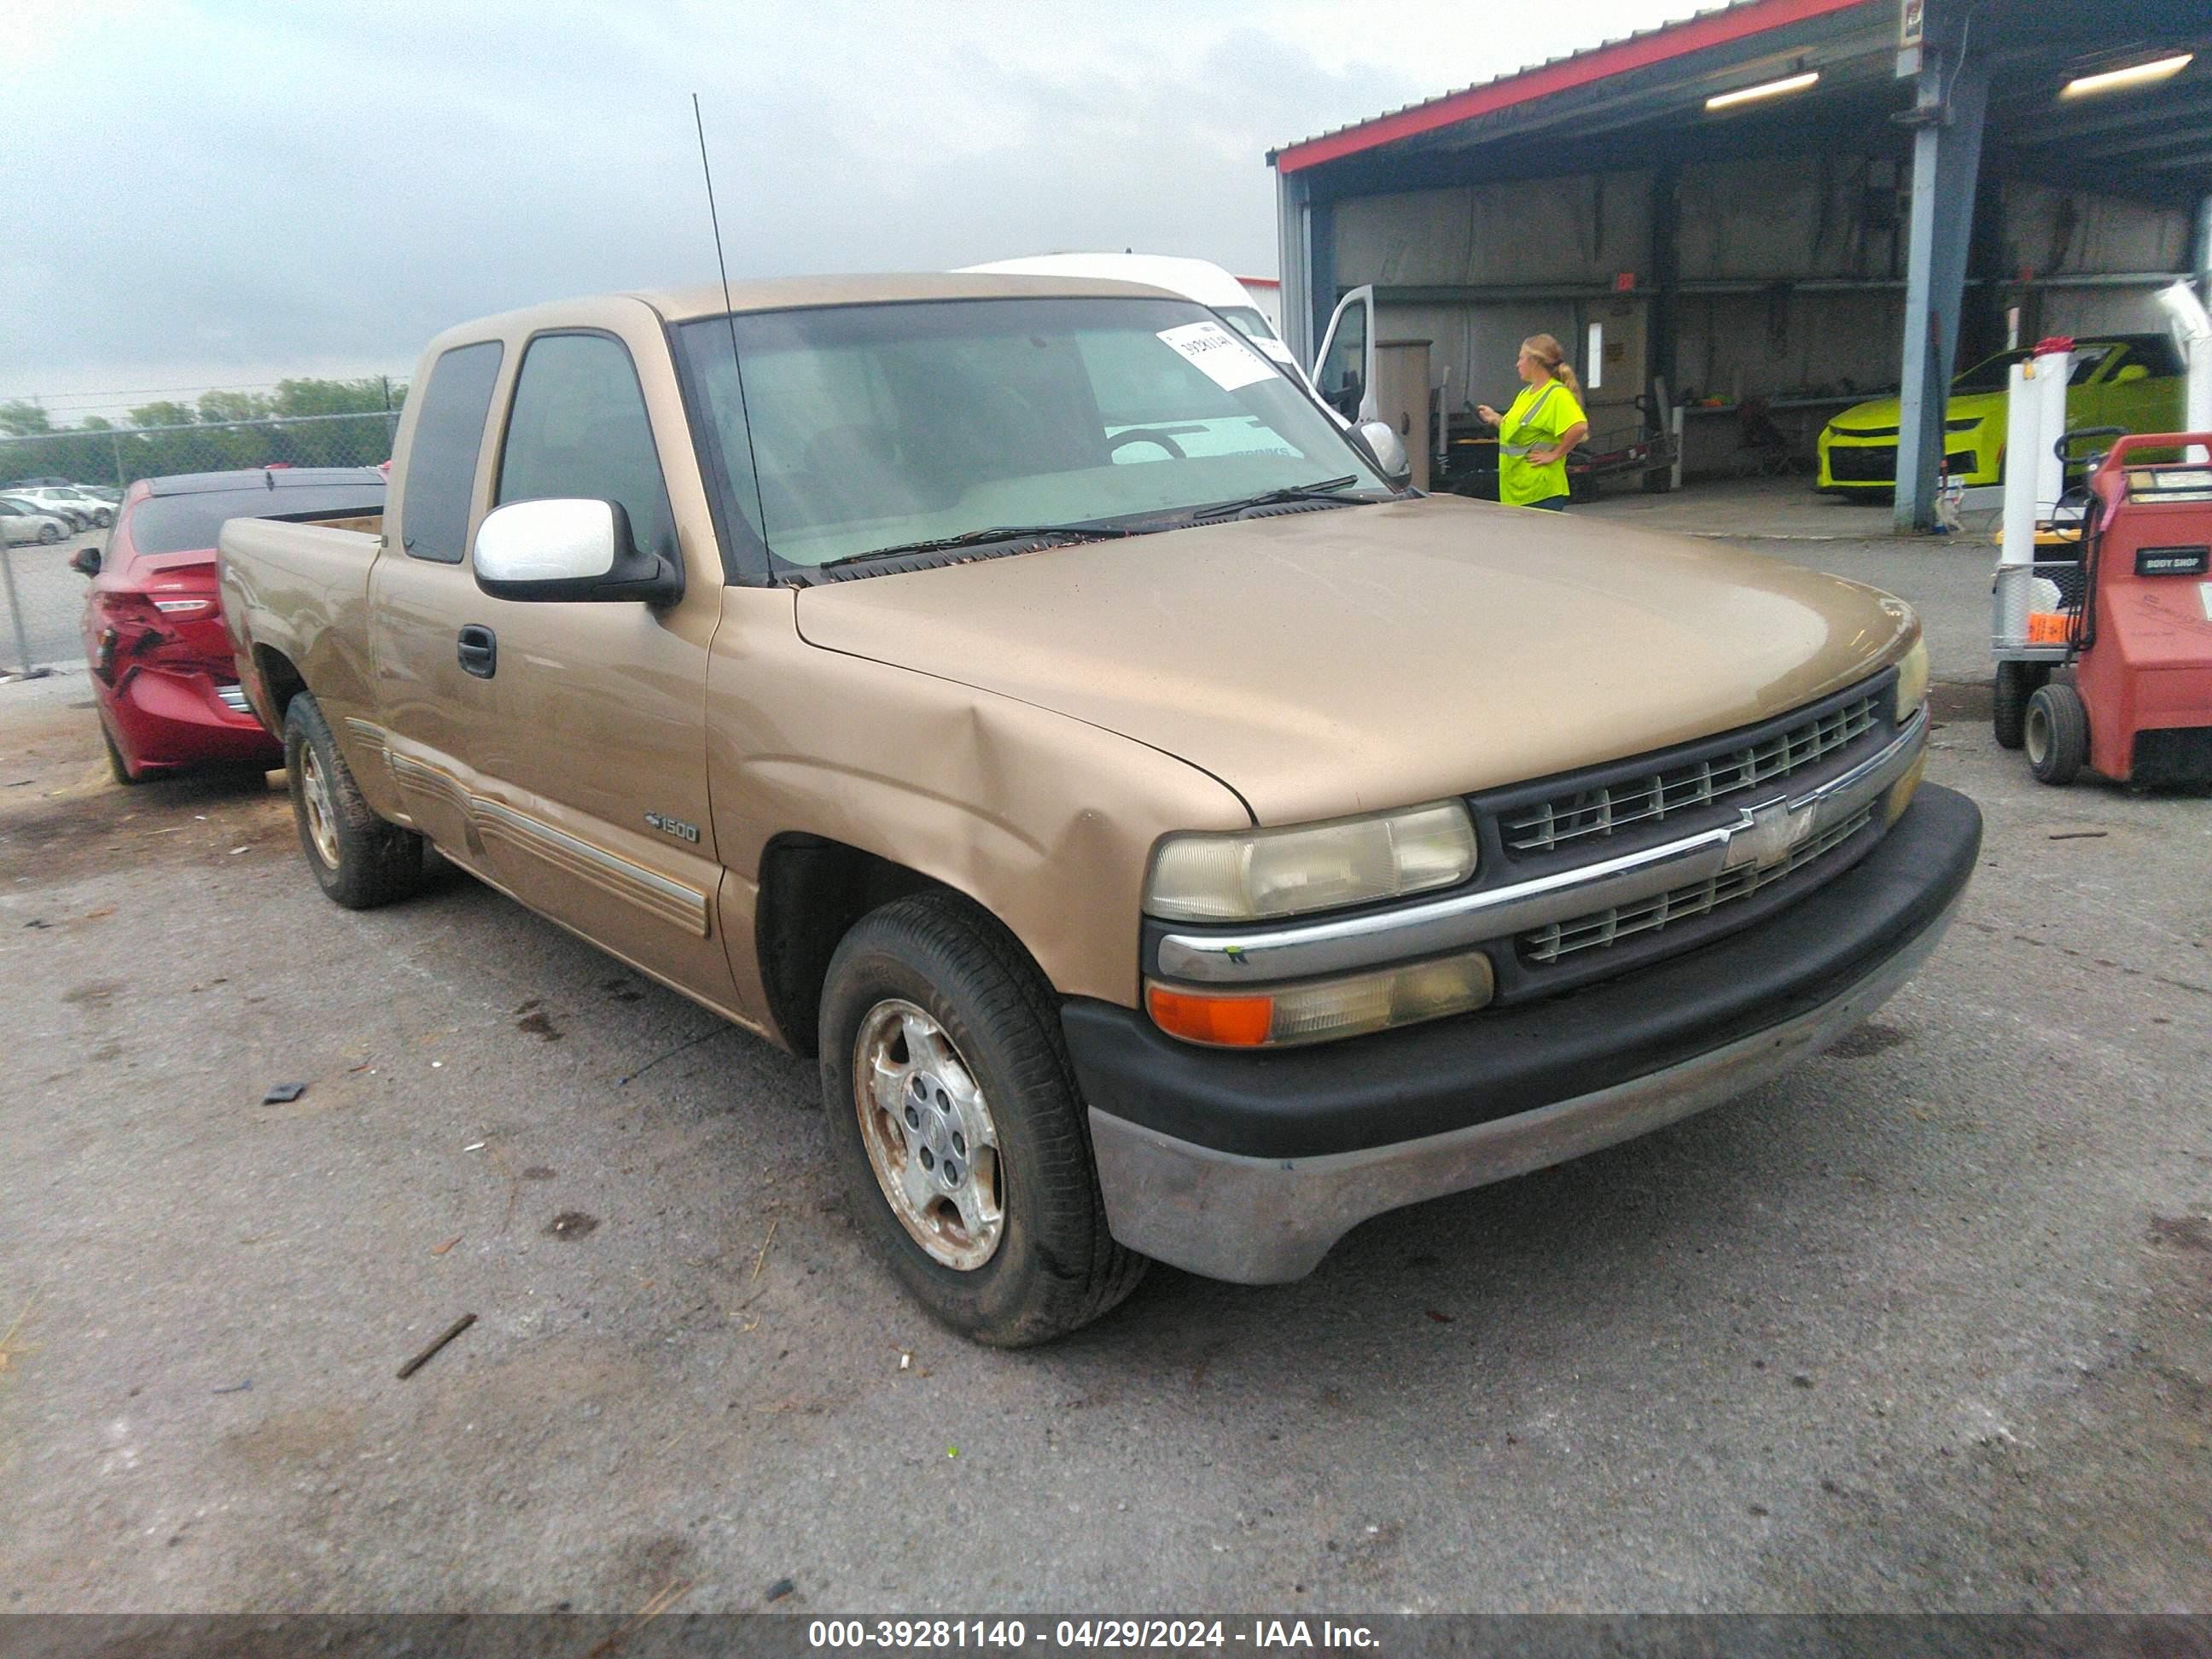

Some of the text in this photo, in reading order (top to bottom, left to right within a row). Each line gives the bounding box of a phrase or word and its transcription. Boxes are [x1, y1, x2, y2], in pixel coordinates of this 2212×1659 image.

[2146, 558, 2199, 568] BODY SHOP
[661, 817, 697, 842] 1500
